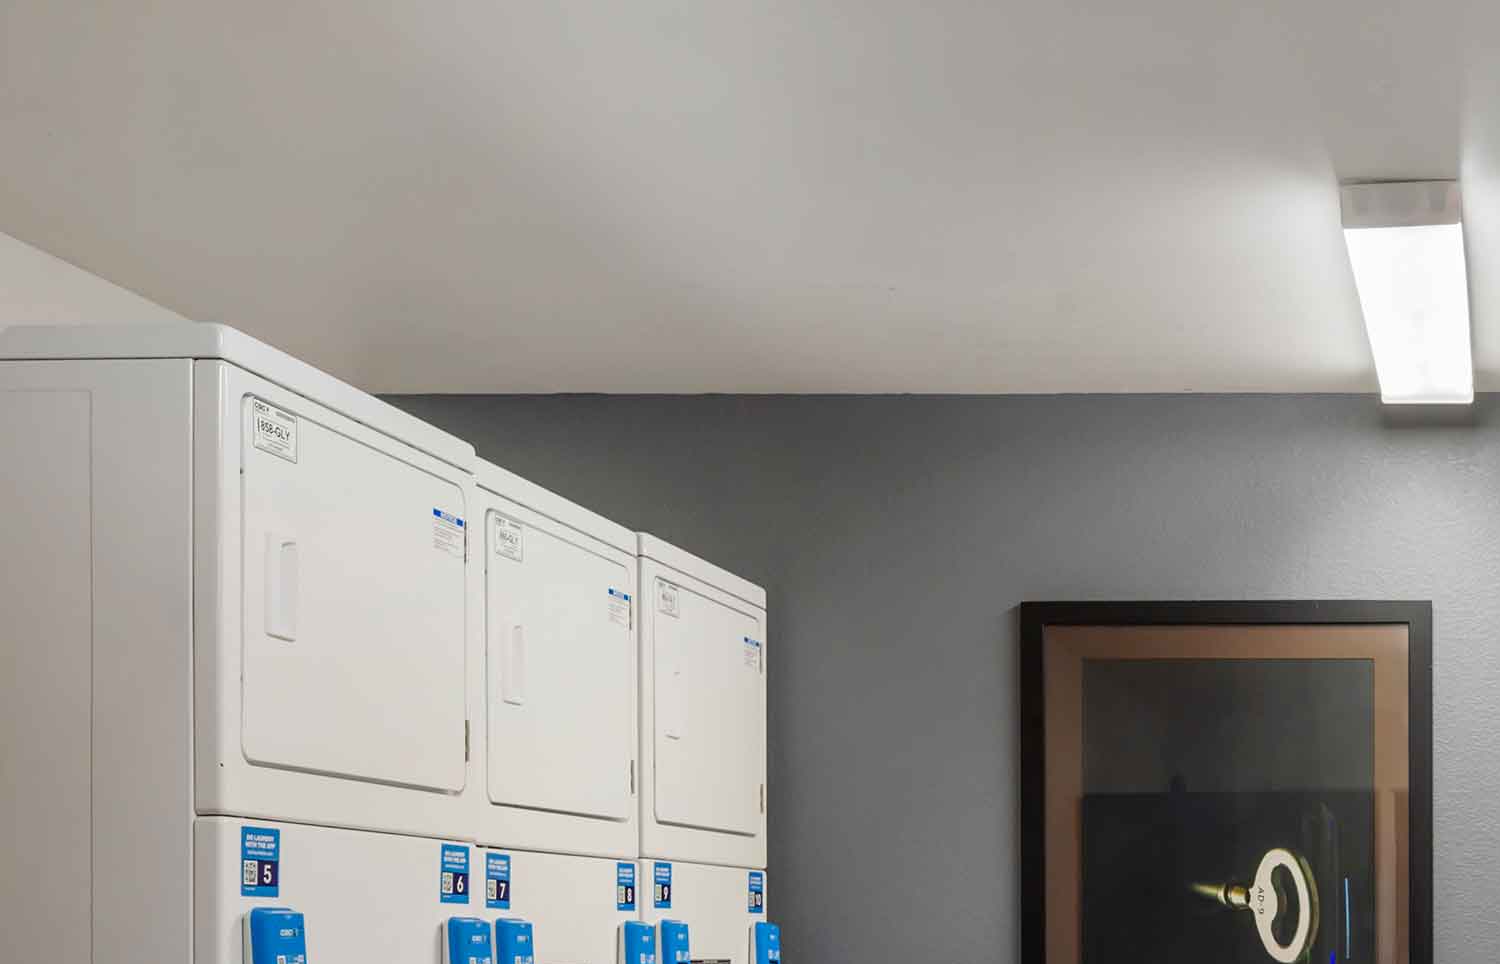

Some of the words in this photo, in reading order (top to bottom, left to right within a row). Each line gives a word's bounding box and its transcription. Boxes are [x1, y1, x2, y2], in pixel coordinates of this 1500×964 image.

[263, 864, 273, 884] 5
[456, 875, 464, 893] 6
[499, 882, 507, 899] 7
[626, 887, 633, 903] 8
[663, 886, 669, 900] 9
